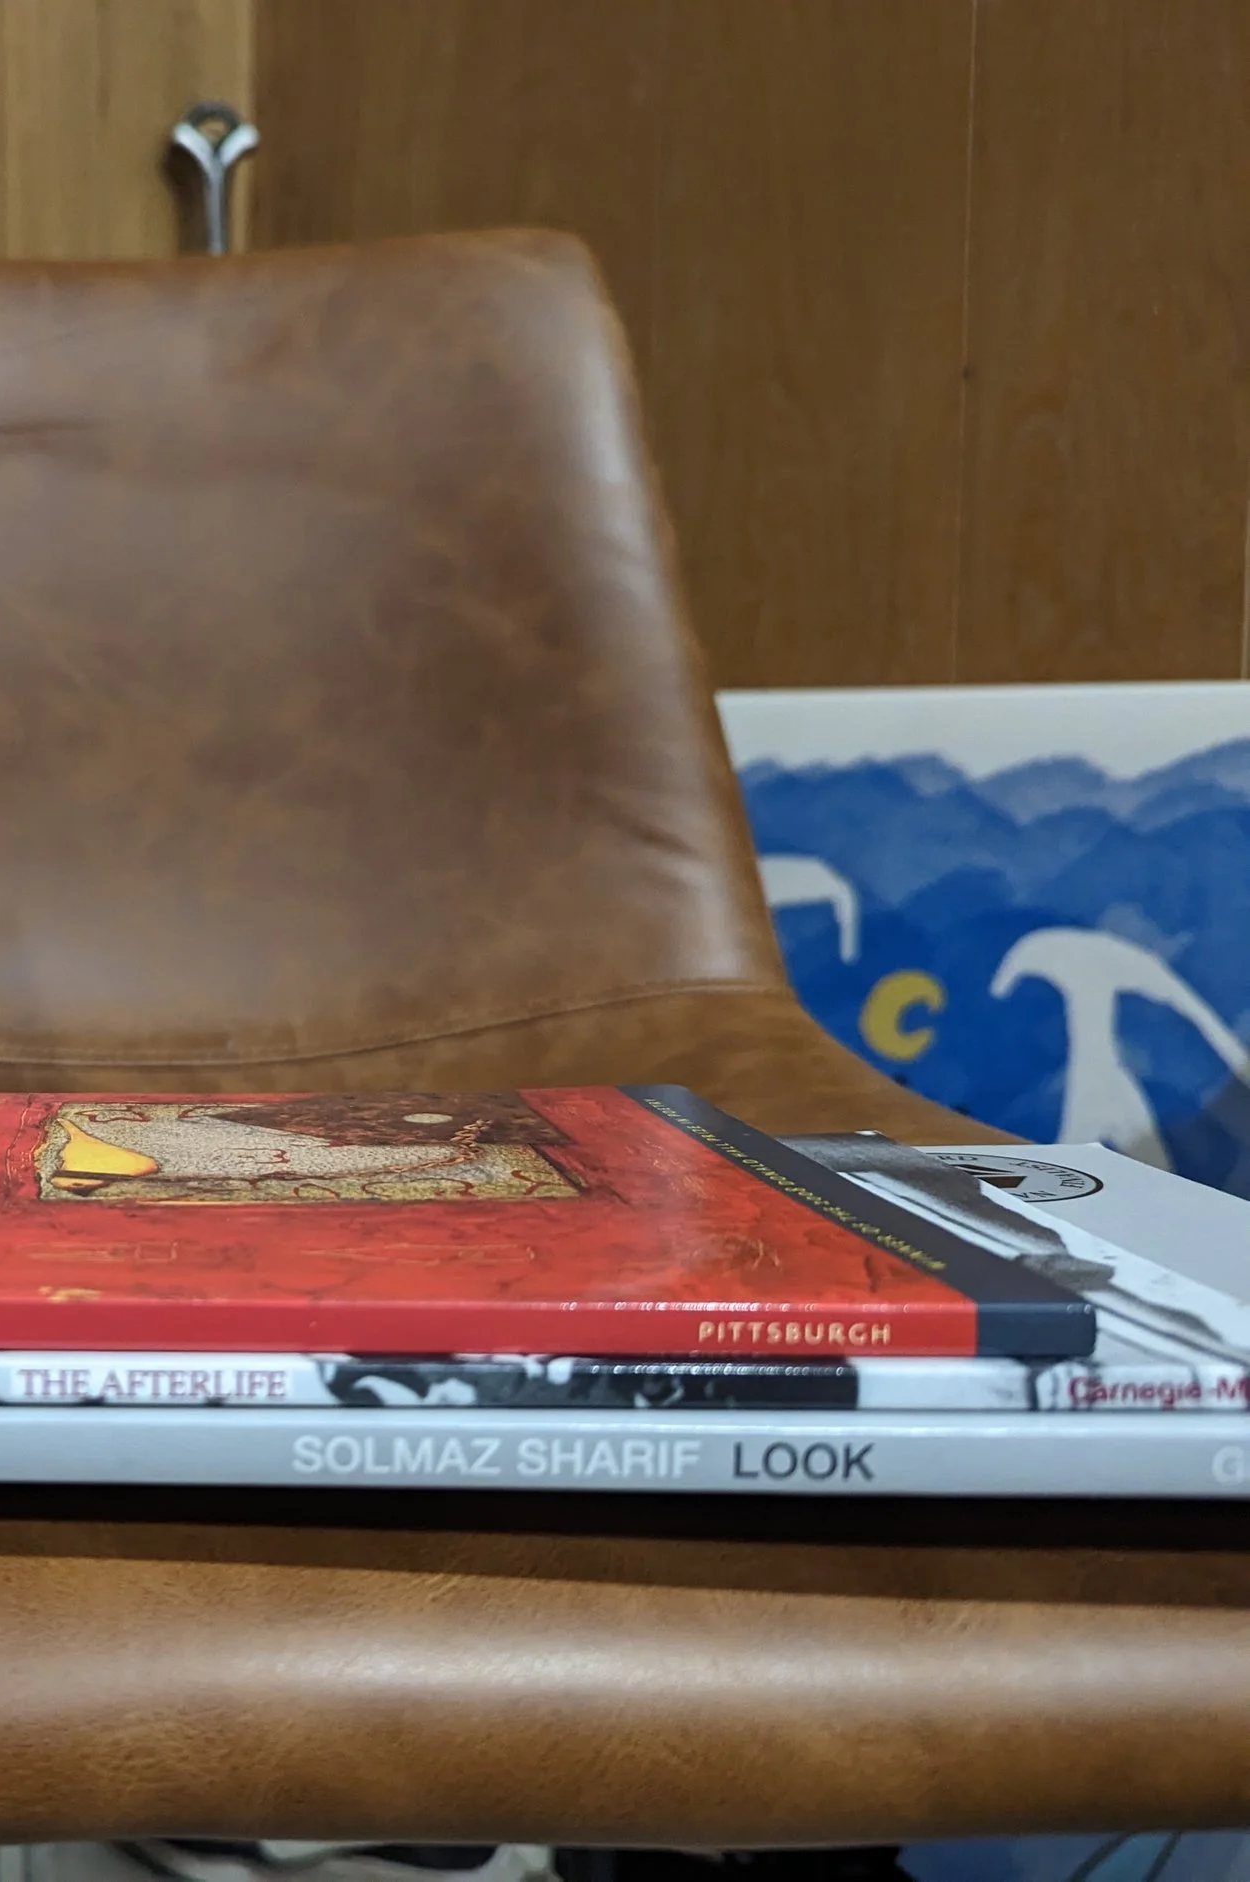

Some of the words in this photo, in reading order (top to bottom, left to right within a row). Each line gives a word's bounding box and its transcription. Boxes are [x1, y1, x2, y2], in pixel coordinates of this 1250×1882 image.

[644, 1098, 681, 1118] POETRY
[686, 1124, 722, 1142] PRIZE
[715, 1143, 748, 1158] HALL
[742, 1158, 796, 1186] DONALD
[1008, 1161, 1086, 1190] FINALIST
[698, 1321, 892, 1345] PITTSBURGH
[17, 1368, 90, 1398] THE
[101, 1368, 287, 1399] AFTERLIFE
[292, 1434, 502, 1476] SOLMAZ
[516, 1437, 701, 1479] SHARIF
[733, 1441, 876, 1481] LOOK
